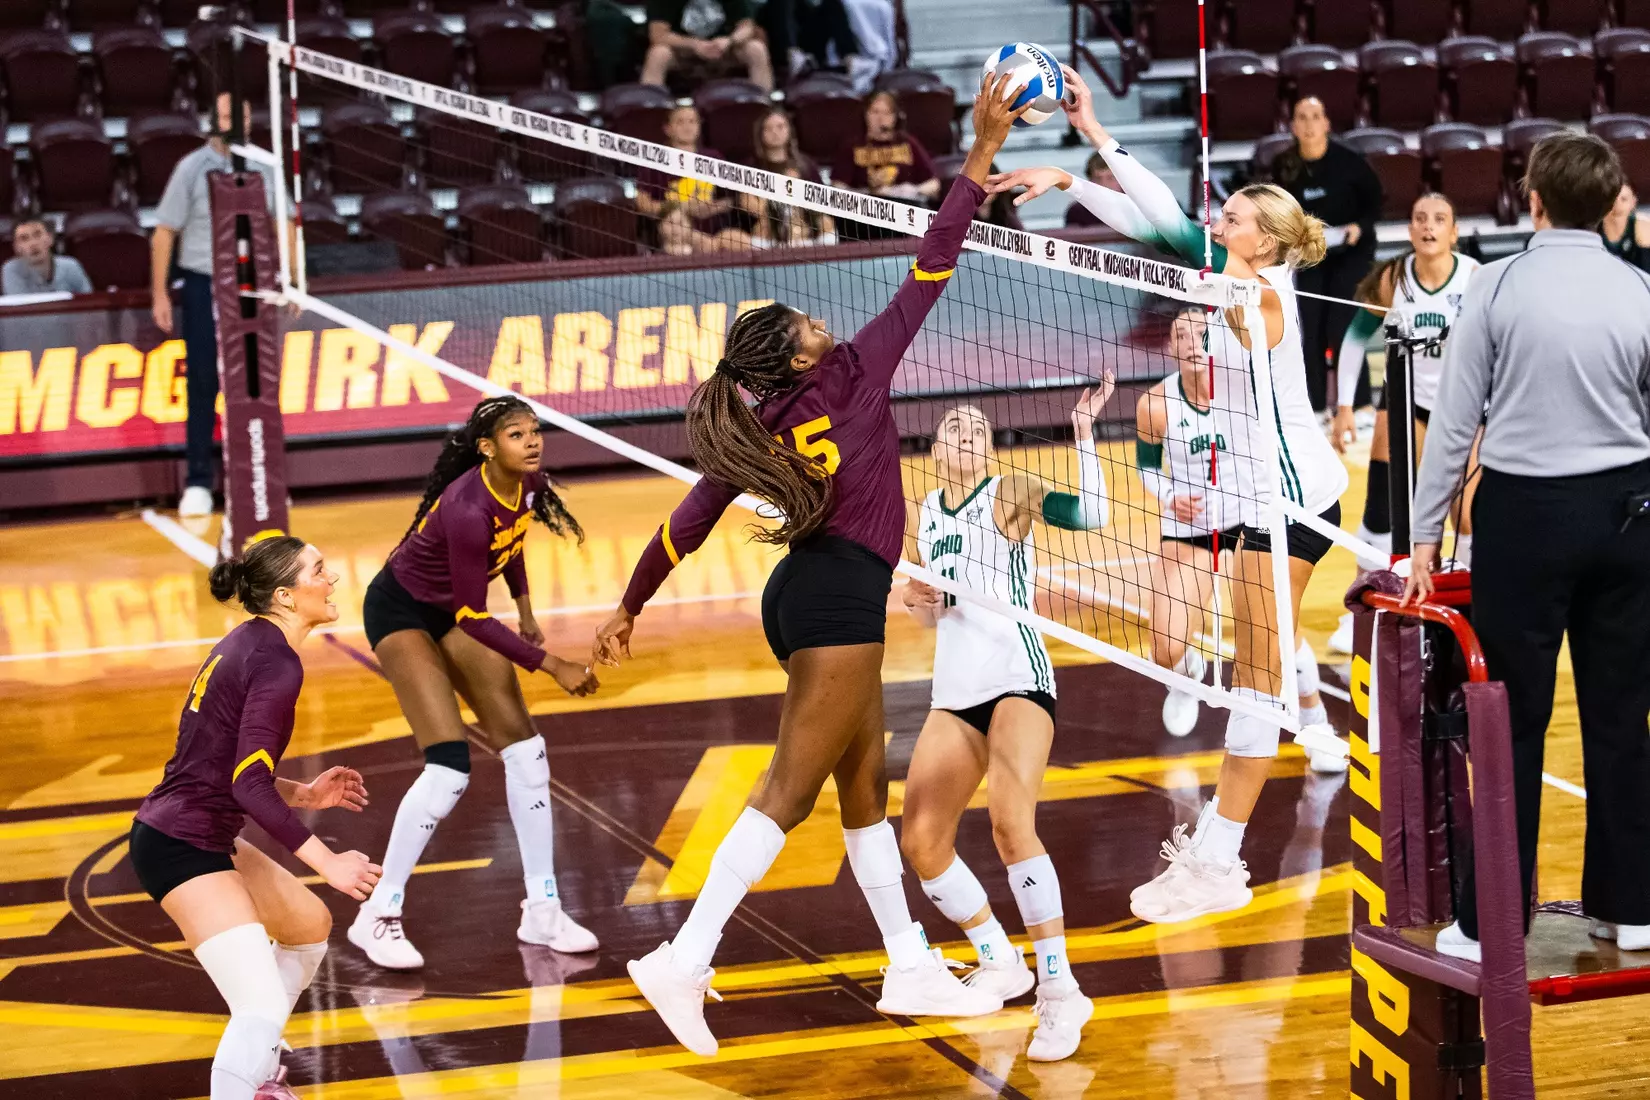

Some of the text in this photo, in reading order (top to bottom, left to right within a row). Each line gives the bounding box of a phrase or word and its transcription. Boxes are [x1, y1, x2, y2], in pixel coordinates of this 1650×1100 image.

[1026, 47, 1055, 88] molten
[804, 183, 896, 223] CENTRAL MICHIGAN VOLLEYBALL
[965, 221, 1033, 257] HIGAN VOLLEYBALL
[1069, 245, 1101, 271] CENTRAL
[1103, 252, 1141, 280] MICHIGAN
[1414, 312, 1446, 328] OHIO
[0, 298, 776, 435] MCGIRK AREN
[1190, 433, 1227, 455] OHO
[931, 534, 963, 562] OHIO
[189, 654, 223, 713] 4
